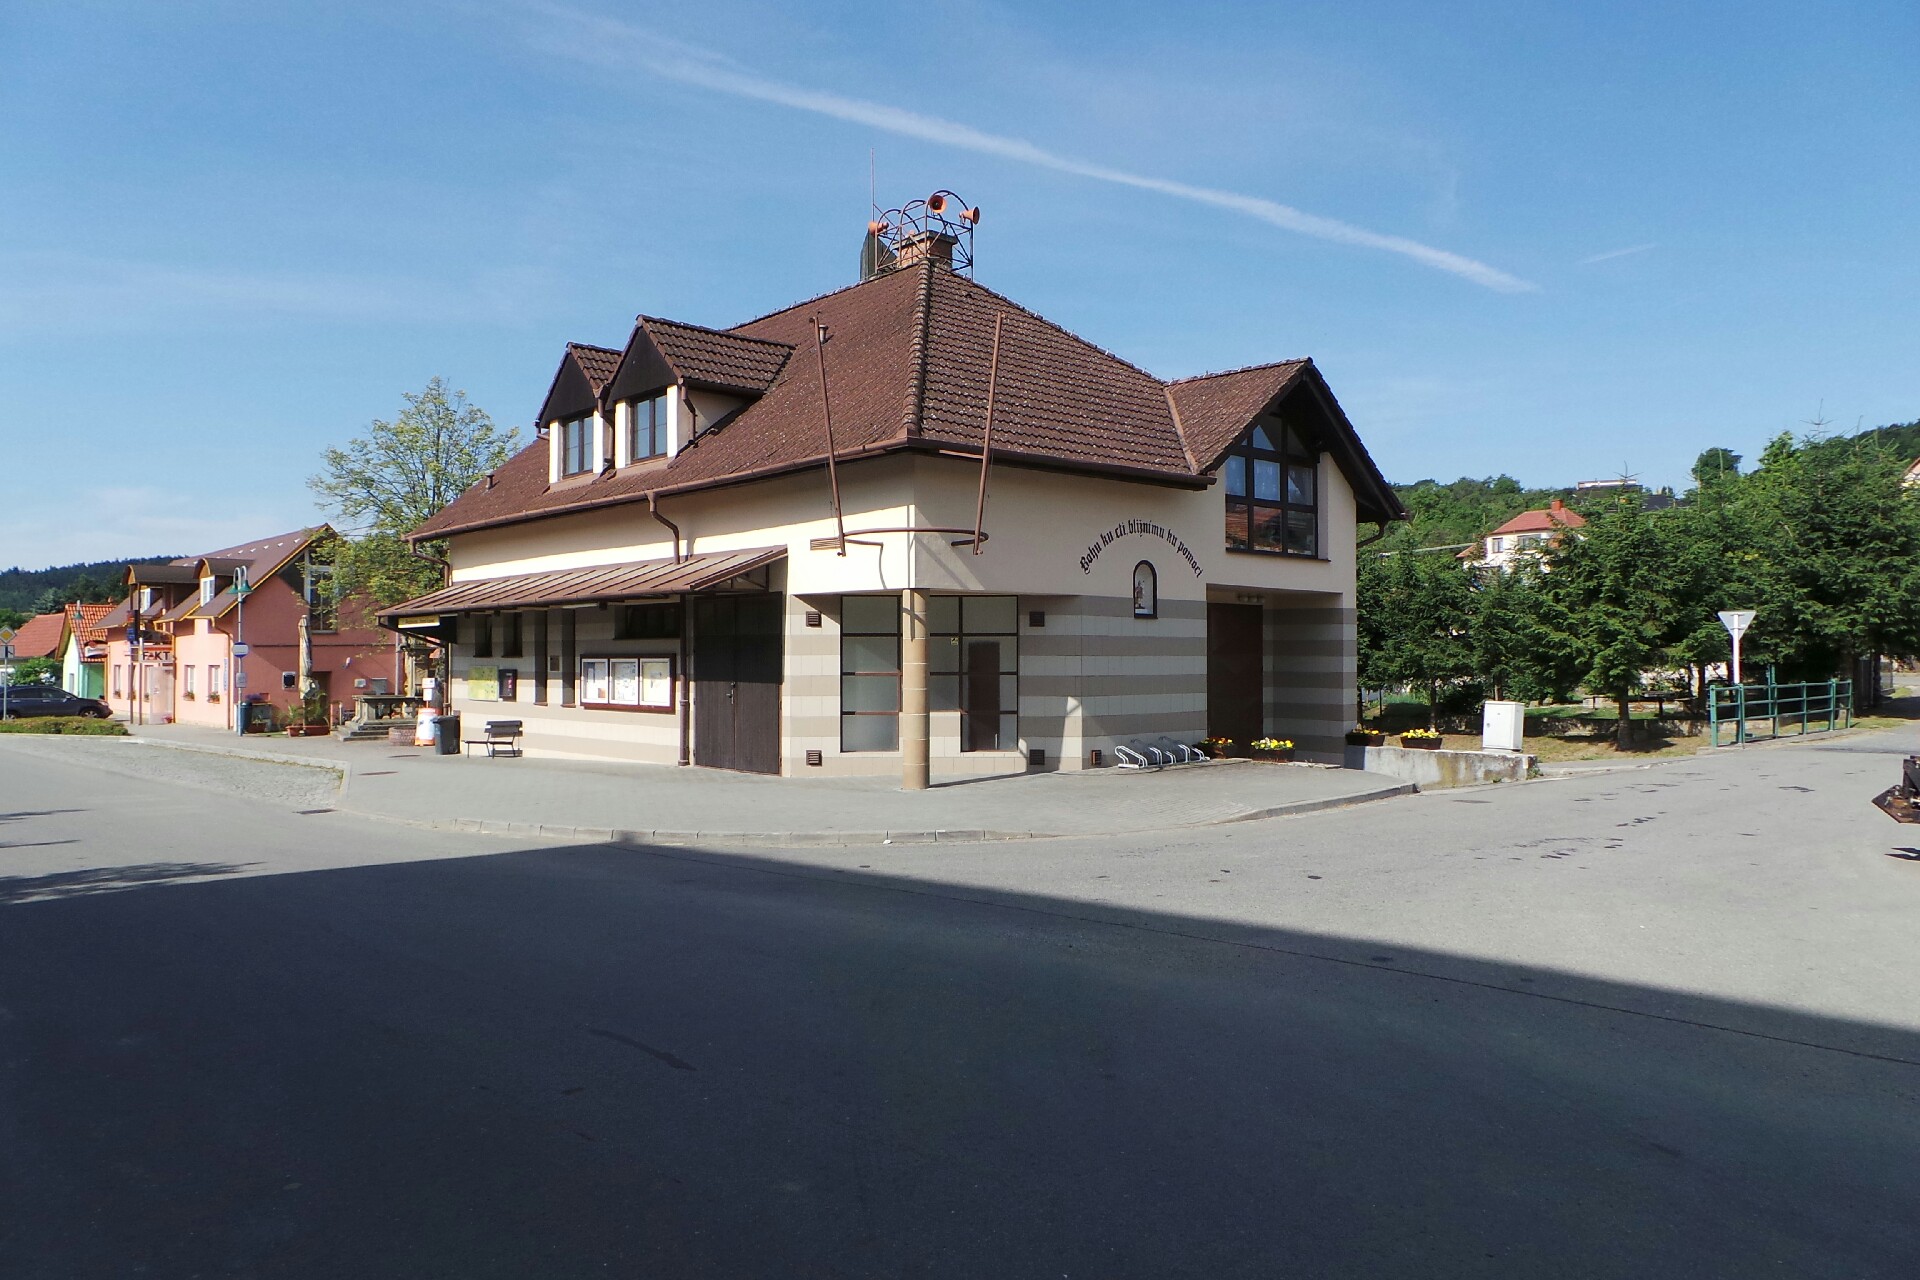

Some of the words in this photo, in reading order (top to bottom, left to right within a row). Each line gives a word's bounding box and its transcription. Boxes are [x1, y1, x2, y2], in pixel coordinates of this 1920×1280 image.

[1100, 531, 1114, 547] ku
[1166, 528, 1178, 547] ku
[1177, 542, 1204, 578] pomoci
